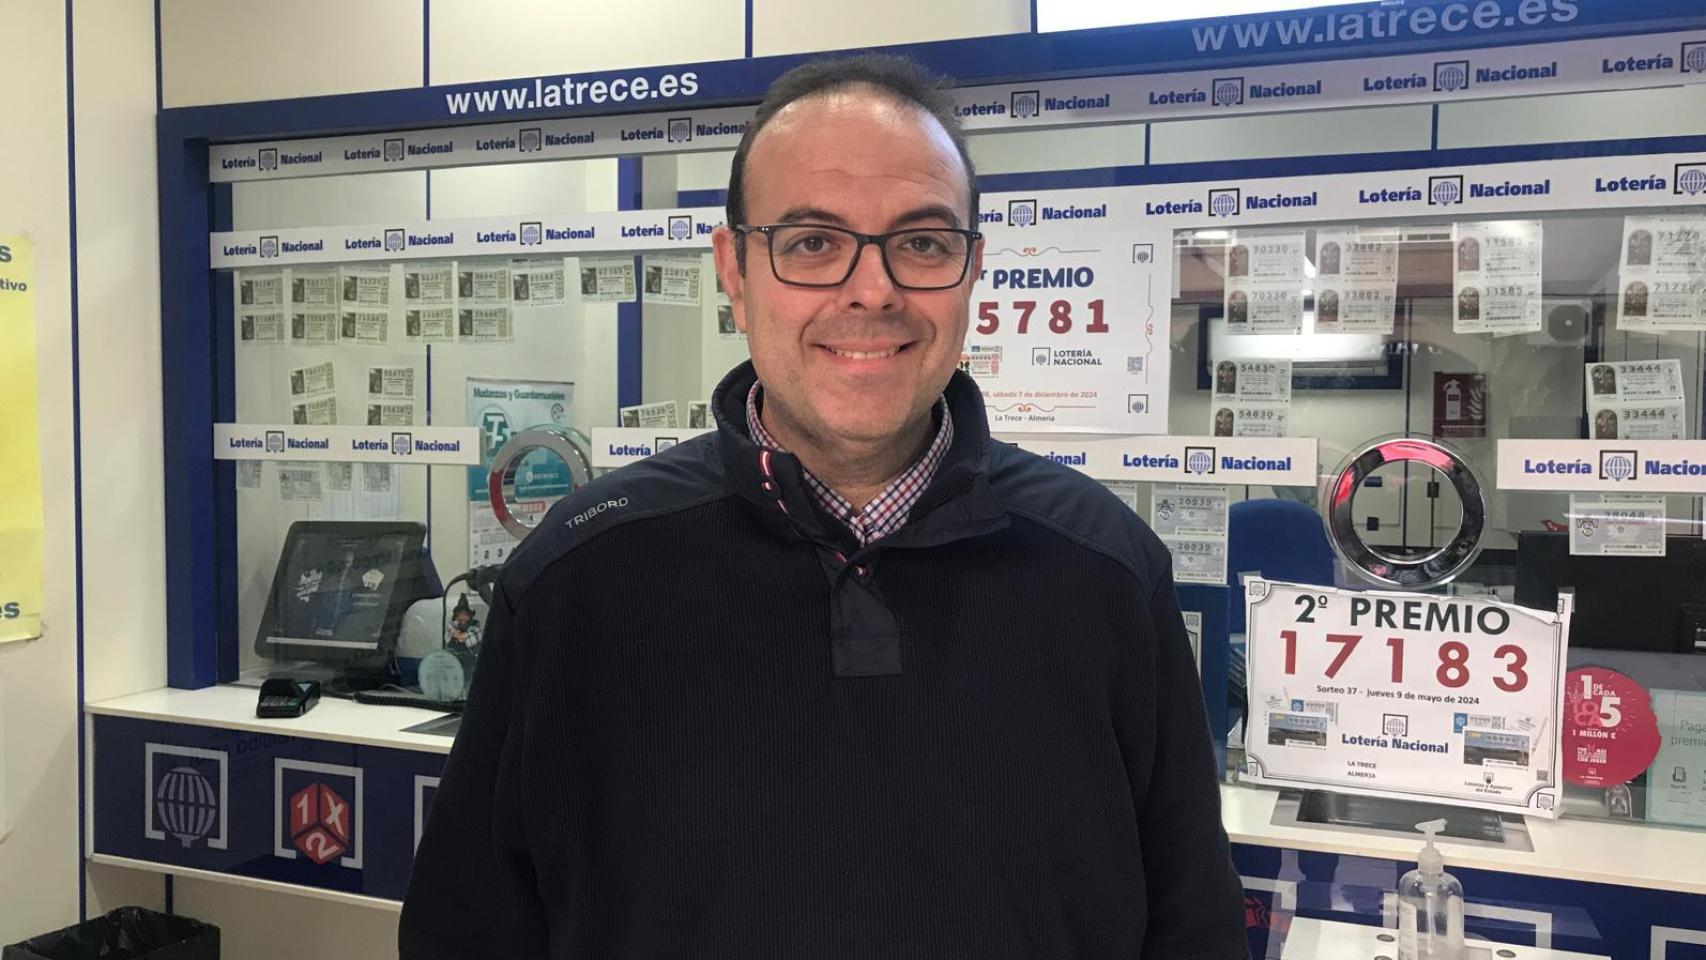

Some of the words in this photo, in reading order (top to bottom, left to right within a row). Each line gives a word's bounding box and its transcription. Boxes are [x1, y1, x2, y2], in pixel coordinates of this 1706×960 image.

[1193, 0, 1579, 52] www.latrece.es
[1602, 54, 1673, 73] Lotería
[1363, 74, 1427, 92] Lotería
[1476, 62, 1557, 82] Nacional
[446, 71, 699, 115] www.latrece.es
[1149, 88, 1206, 105] Lotería
[1249, 80, 1321, 99] Nacional
[954, 101, 1006, 116] Lotería
[1045, 94, 1110, 111] Nacional
[476, 137, 516, 152] Lotería
[545, 131, 594, 146] Nacional
[621, 126, 664, 141] Lotería
[222, 155, 256, 169] Lotería
[280, 152, 322, 166] Nacional
[344, 146, 381, 161] Lotería
[408, 141, 453, 156] Nacional
[1359, 186, 1422, 204] Lotería
[1470, 179, 1550, 198] Nacional
[1595, 174, 1667, 194] Lotería
[1146, 198, 1203, 216] Lotería
[1246, 191, 1317, 210] Nacional
[978, 209, 1003, 223] ería
[1042, 204, 1106, 221] Nacional
[476, 228, 517, 244] Lotería
[545, 226, 595, 241] Nacional
[621, 223, 664, 239] Lotería
[223, 242, 257, 257] Lotería
[281, 239, 323, 253] Nacional
[345, 235, 381, 250] Lotería
[408, 232, 453, 247] Nacional
[0, 279, 27, 292] tivo
[993, 267, 1094, 289] PREMIO
[976, 299, 1109, 335] 5781
[1054, 347, 1092, 357] LOTERÍA
[1054, 357, 1102, 366] NACIONAL
[993, 390, 1017, 398] sábado
[1034, 390, 1069, 398] diciembre
[230, 437, 263, 448] Lotería
[287, 438, 329, 449] Nacional
[352, 439, 388, 451] Lotería
[415, 440, 460, 452] Nacional
[609, 443, 651, 456] Lotería
[1044, 451, 1086, 465] ional
[1123, 453, 1179, 469] Lotería
[1221, 456, 1292, 471] Nacional
[1524, 459, 1592, 474] Lotería
[1645, 460, 1706, 475] Nacion
[565, 497, 629, 529] TRIBORD
[484, 550, 490, 559] 2
[1294, 594, 1328, 623] 2º
[1350, 597, 1510, 635] PREMIO
[1280, 630, 1528, 692] 17183
[1316, 685, 1345, 695] Sorteo
[1366, 690, 1394, 698] jueves
[1397, 691, 1402, 699] 9
[1404, 692, 1415, 700] de
[1418, 693, 1441, 703] mayo
[1444, 695, 1456, 703] de
[1457, 696, 1480, 705] 2024
[1581, 675, 1592, 700] 1
[1600, 696, 1622, 728] 5
[1342, 733, 1388, 748] Lotería
[1391, 739, 1449, 754] Nacional
[1357, 761, 1377, 769] TRECE
